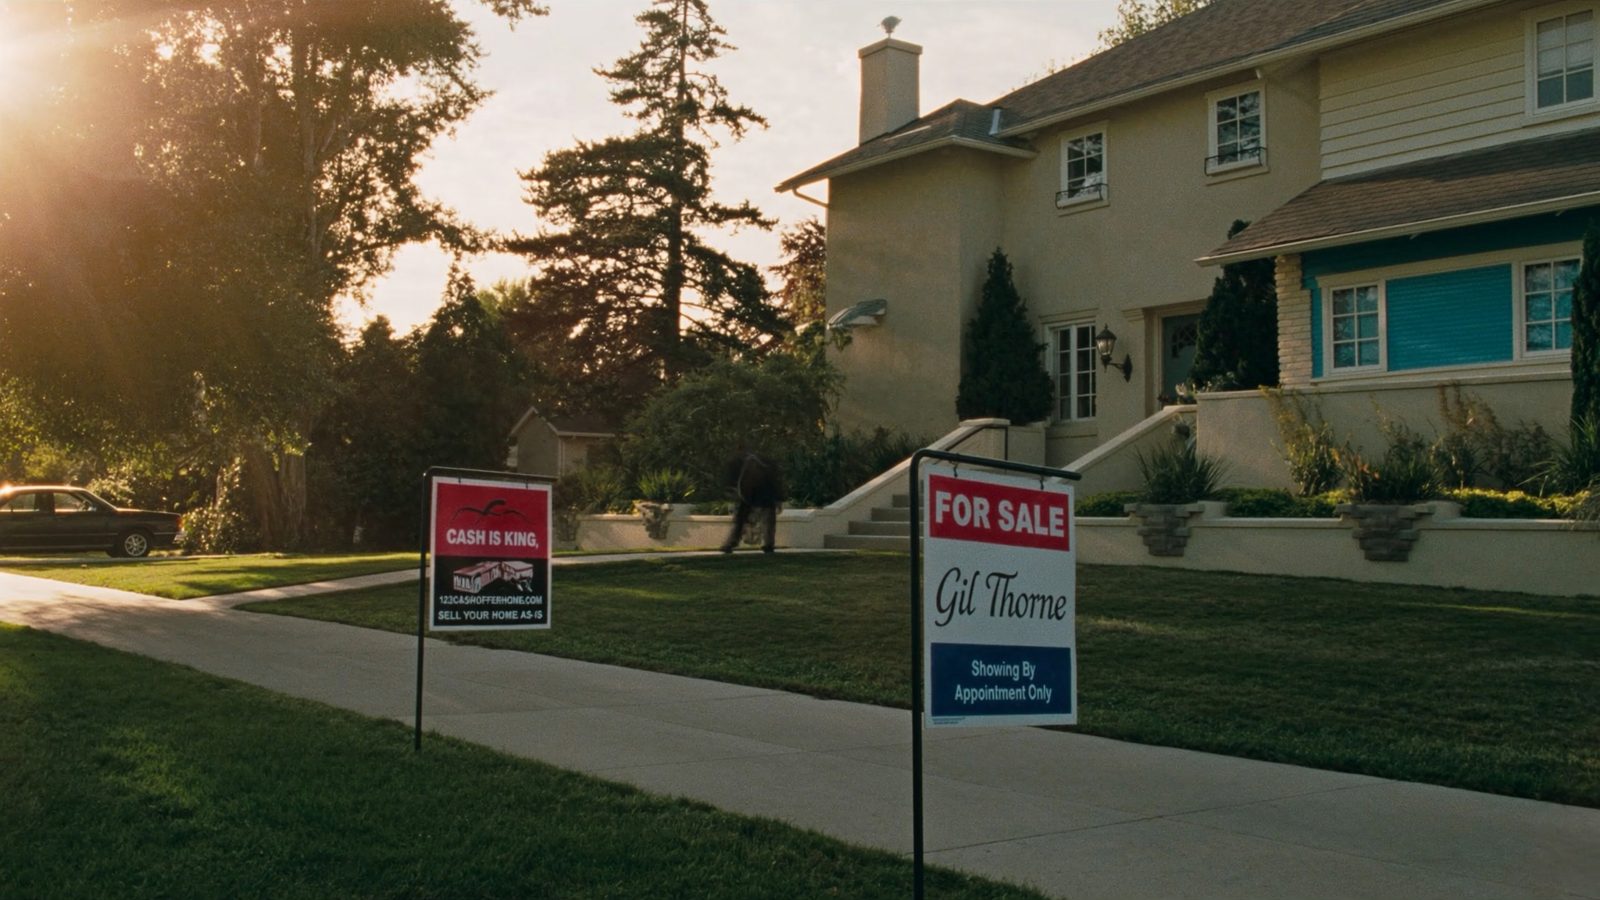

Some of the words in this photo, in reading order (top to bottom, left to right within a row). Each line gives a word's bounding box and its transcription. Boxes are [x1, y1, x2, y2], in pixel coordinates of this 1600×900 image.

[935, 490, 990, 529] FOR
[998, 499, 1065, 538] SALE
[446, 528, 486, 545] CASH
[489, 531, 501, 545] IS
[504, 531, 539, 549] KING,
[934, 567, 981, 627] Gil
[985, 571, 1067, 621] Thorne
[438, 611, 461, 620] SELL
[463, 610, 489, 620] YOUR
[492, 610, 518, 620] HOME
[520, 610, 543, 620] AS-IS
[971, 660, 1020, 681] Showing
[1022, 661, 1036, 679] By
[954, 685, 1026, 704] Appointment
[1028, 684, 1052, 703] Only
